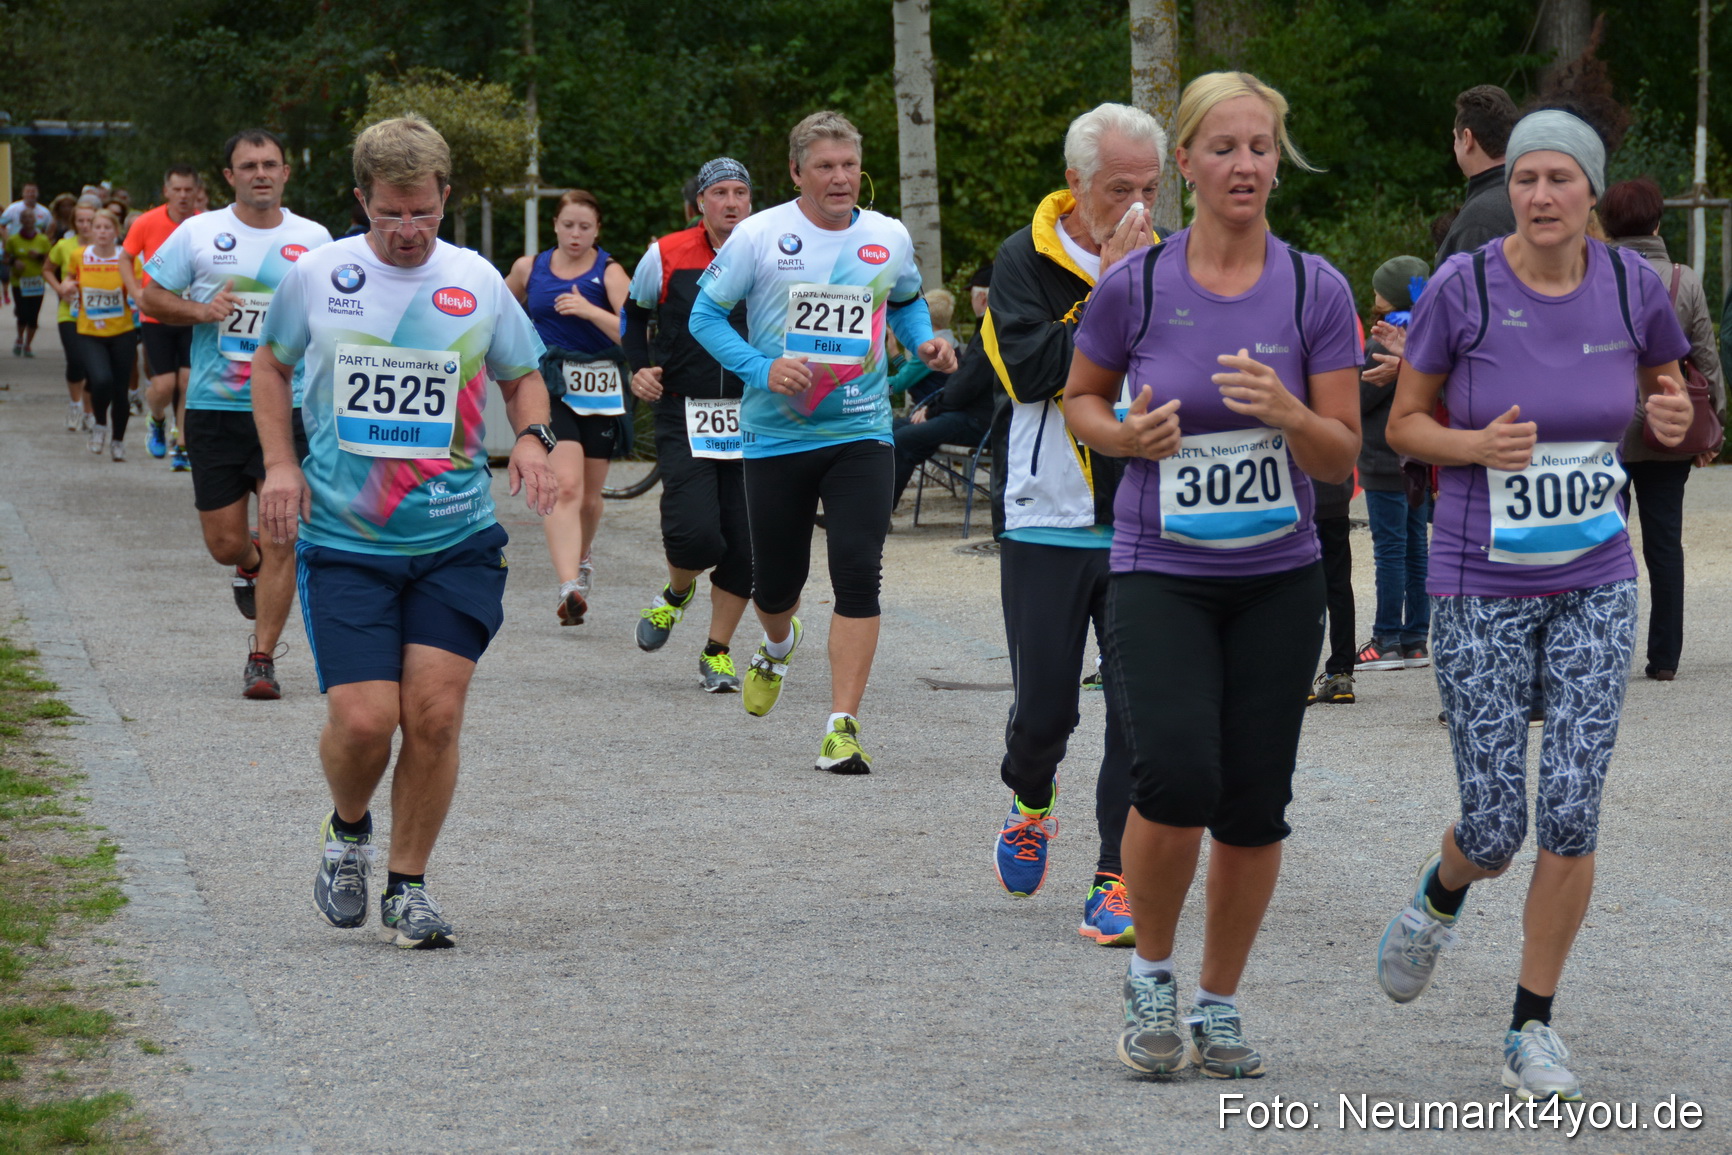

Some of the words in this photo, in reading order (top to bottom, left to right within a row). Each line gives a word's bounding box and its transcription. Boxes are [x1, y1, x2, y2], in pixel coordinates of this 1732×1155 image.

[328, 297, 364, 310] PARTL
[439, 292, 473, 310] Hervis
[791, 291, 819, 299] PARTL
[820, 292, 860, 302] Neumarkt
[328, 307, 364, 317] Neumarkt
[794, 301, 865, 335] 2212
[814, 339, 842, 353] Felix
[1254, 342, 1290, 354] Kristina
[338, 354, 379, 368] PARTL
[382, 357, 440, 371] Neumarkt
[569, 370, 617, 393] 3034
[843, 384, 863, 397] 16.
[347, 372, 446, 417] 2525
[369, 424, 421, 443] Rudolf
[1163, 447, 1209, 461] ARTL
[1210, 439, 1269, 457] Neumarkt
[1176, 456, 1282, 508] 3020
[1504, 470, 1616, 521] 3009
[428, 498, 473, 519] Stadtlauf
